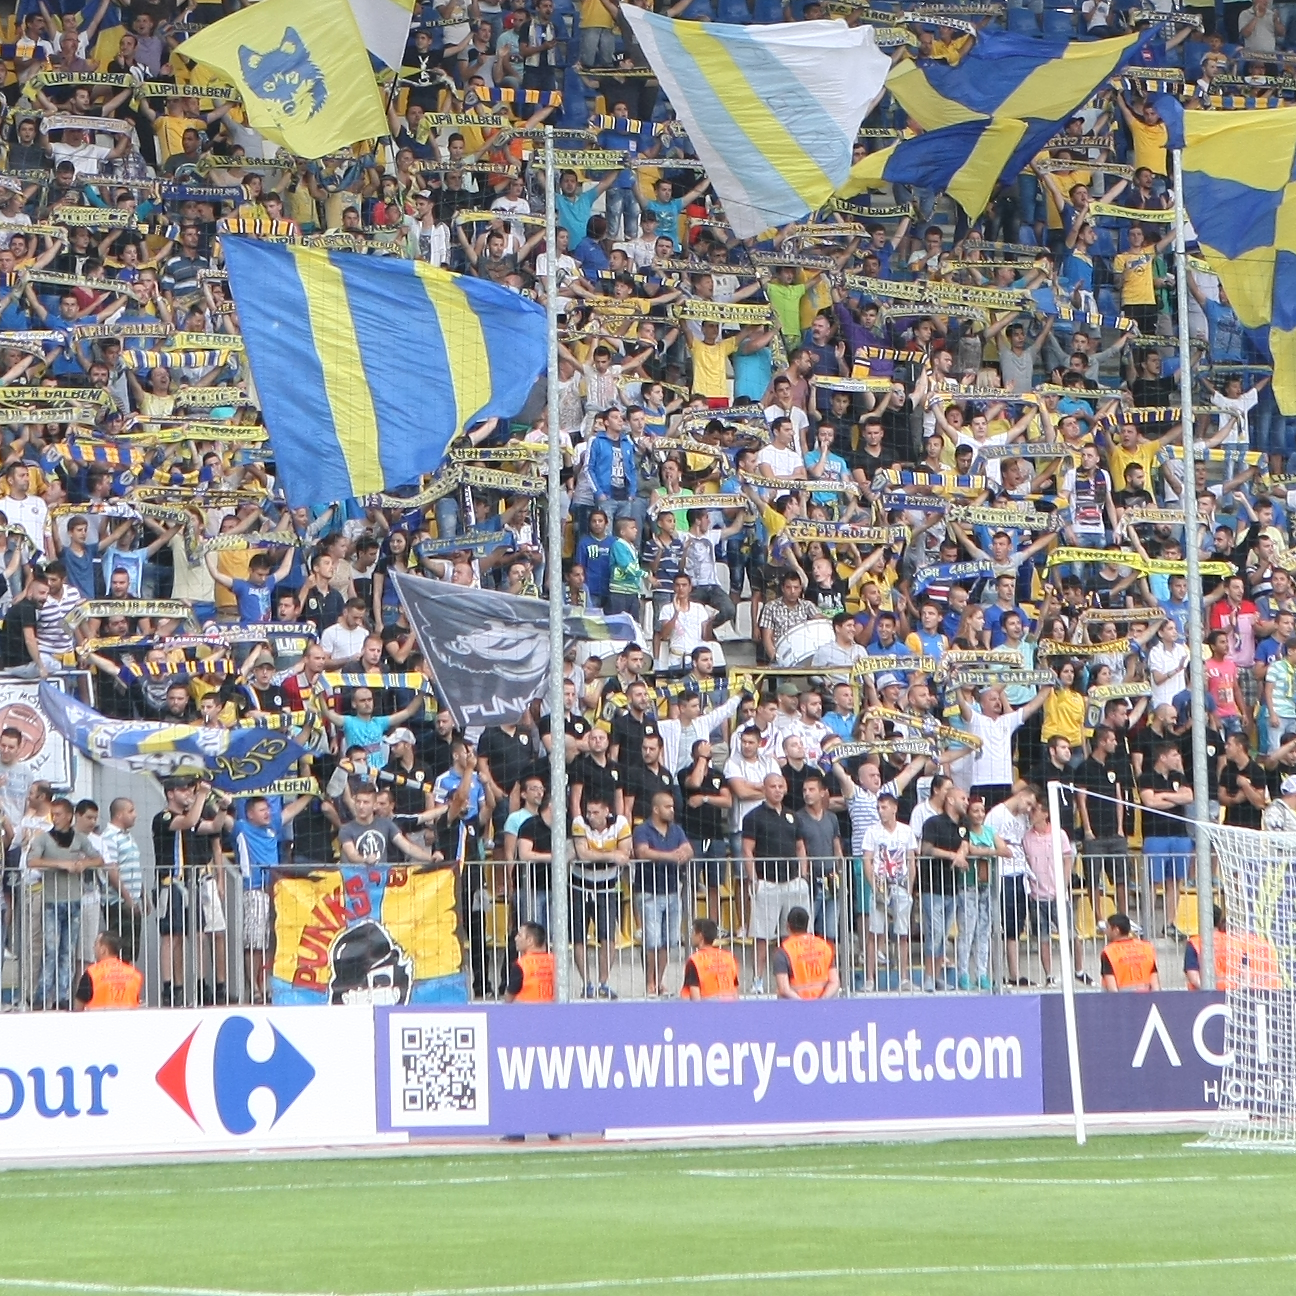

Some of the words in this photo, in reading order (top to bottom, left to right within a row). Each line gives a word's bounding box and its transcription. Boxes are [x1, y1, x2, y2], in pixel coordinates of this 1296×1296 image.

[44, 72, 74, 85] LUPII
[77, 71, 126, 86] GALBENI
[148, 83, 178, 96] LUPII
[182, 85, 232, 99] GALBENI
[186, 334, 244, 348] PETROL
[3, 387, 37, 400] LUPII
[44, 387, 103, 402] GALBENI
[292, 878, 372, 992] PUNKS
[497, 1021, 1023, 1103] www.winery-outlet.com
